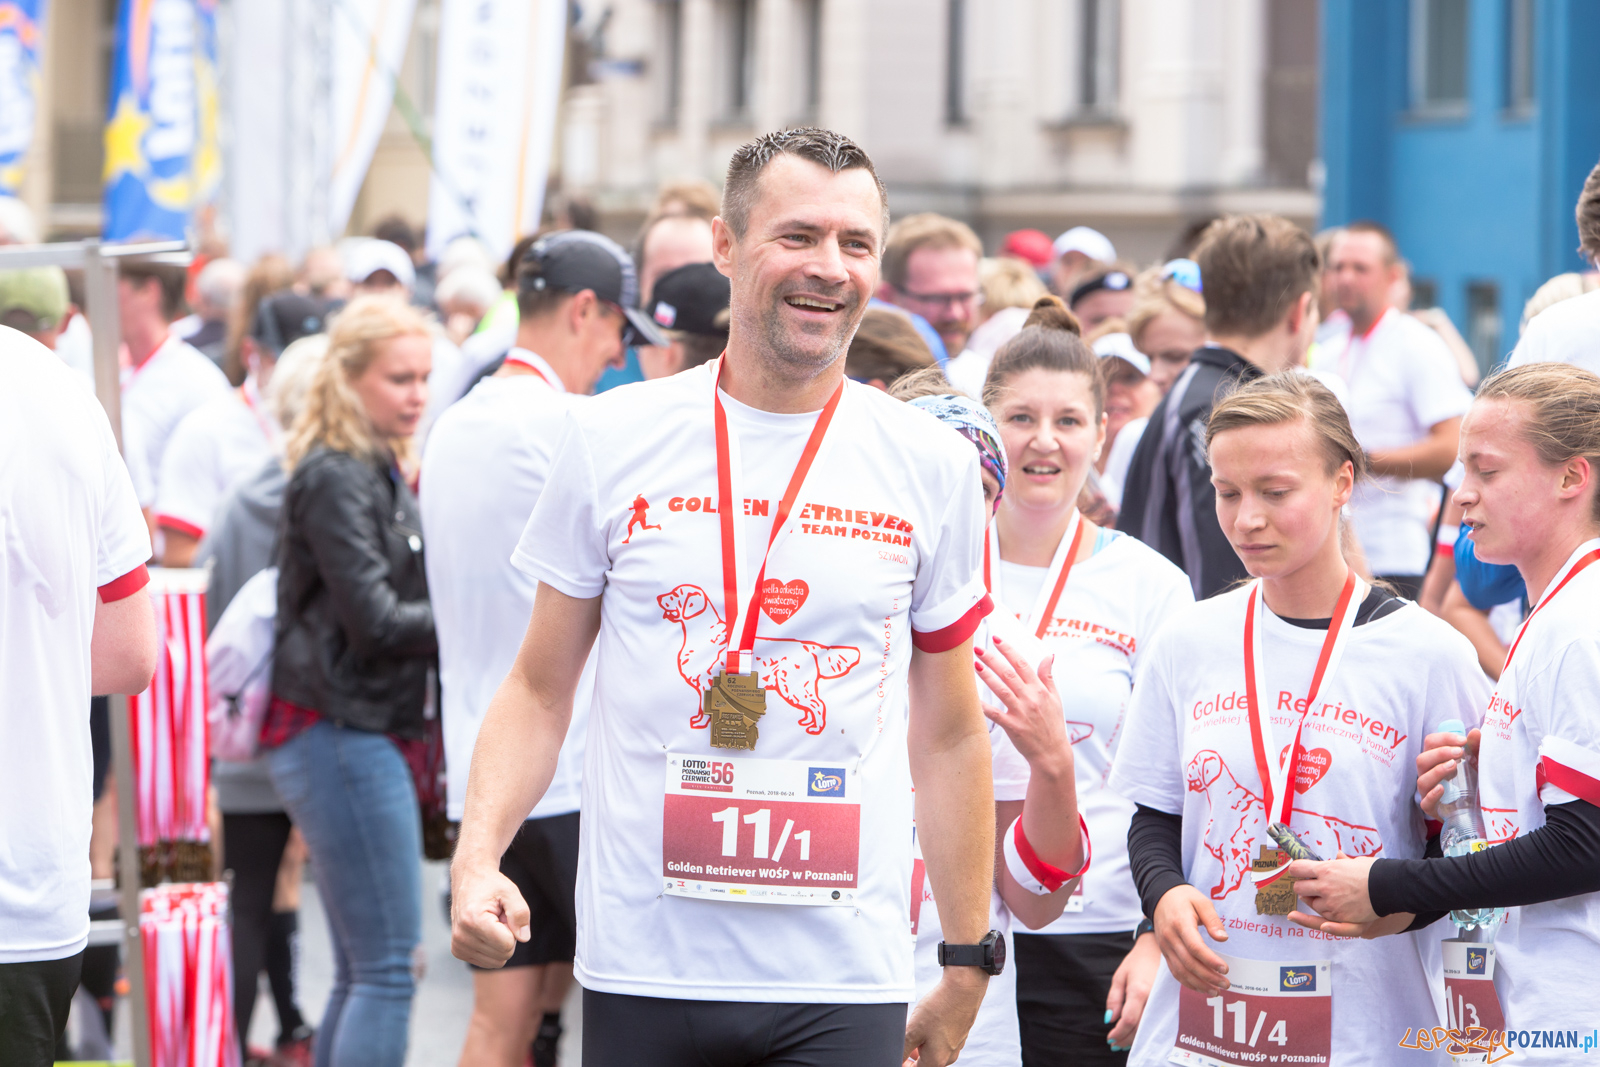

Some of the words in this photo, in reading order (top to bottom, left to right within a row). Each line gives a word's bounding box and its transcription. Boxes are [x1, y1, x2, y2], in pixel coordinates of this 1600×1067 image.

[668, 497, 769, 516] GOLEN
[778, 501, 914, 533] ETRIEVER
[801, 523, 847, 537] TEAM
[851, 528, 912, 548] POZNAN
[878, 550, 908, 565] SZYMON
[769, 605, 793, 619] pomocy
[1193, 691, 1248, 721] Golde
[682, 759, 706, 769] LOTTO
[681, 768, 711, 776] POZNAŃSKI
[681, 774, 711, 783] CZERWIEC
[817, 778, 837, 789] LOTTO
[1295, 775, 1314, 788] omocy
[711, 806, 811, 863] 11/1
[667, 861, 703, 874] Golden
[706, 865, 757, 879] Retriever
[759, 866, 790, 880] WOŚP
[792, 871, 802, 880] w
[804, 870, 854, 882] Poznaniu
[1254, 860, 1278, 868] POZNAŃ
[1228, 917, 1283, 939] zbierają
[1287, 927, 1304, 937] na
[1289, 975, 1308, 985] LOTTO
[1206, 995, 1288, 1048] 11/4
[1180, 1034, 1206, 1049] Golden
[1206, 1042, 1239, 1060] Retriever
[1240, 1051, 1267, 1063] WOŚP
[1269, 1055, 1278, 1063] w
[1281, 1053, 1327, 1064] Poznaniu
